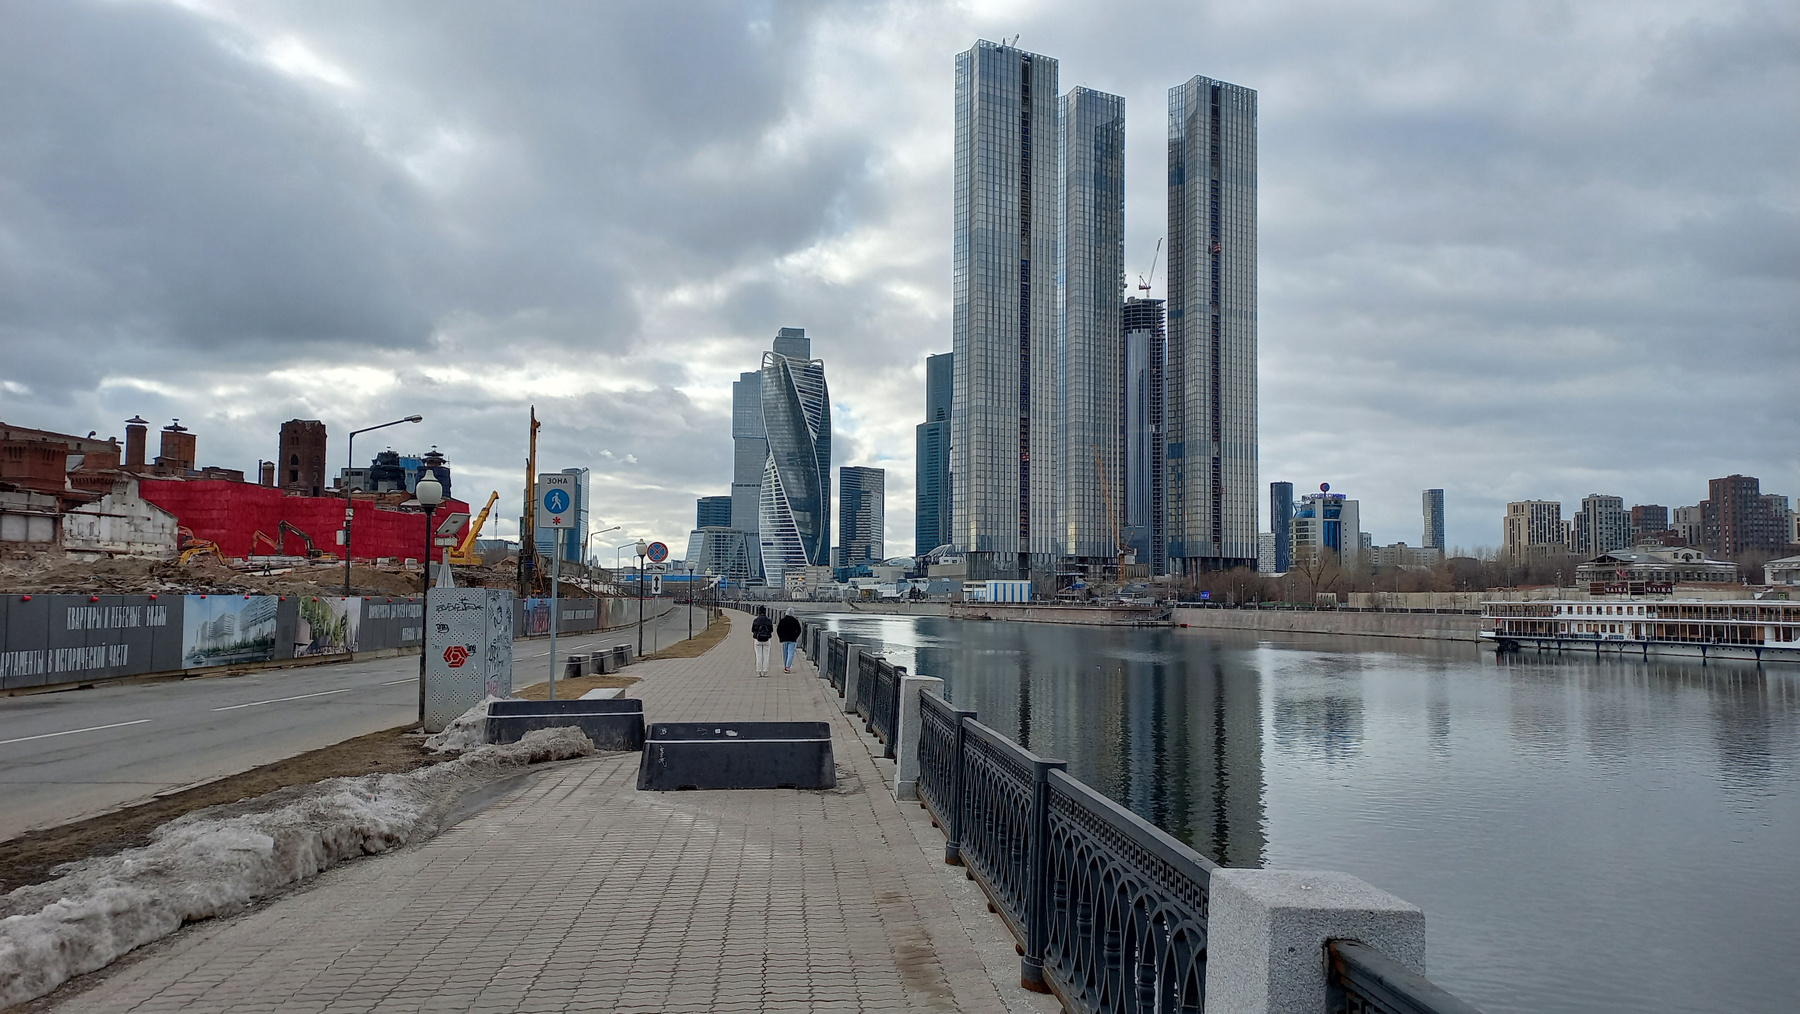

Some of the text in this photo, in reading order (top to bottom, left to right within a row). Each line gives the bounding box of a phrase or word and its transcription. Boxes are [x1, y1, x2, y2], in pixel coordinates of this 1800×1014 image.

[547, 477, 568, 485] ЗОНА
[67, 606, 167, 630] КВАРТИРЫ И НЕБЕСНЫЕ ВИЛЛЫ
[47, 649, 53, 673] В
[55, 642, 106, 673] ИСТОРИЧЕСКОЙ
[109, 644, 129, 667] ЧАСТИ
